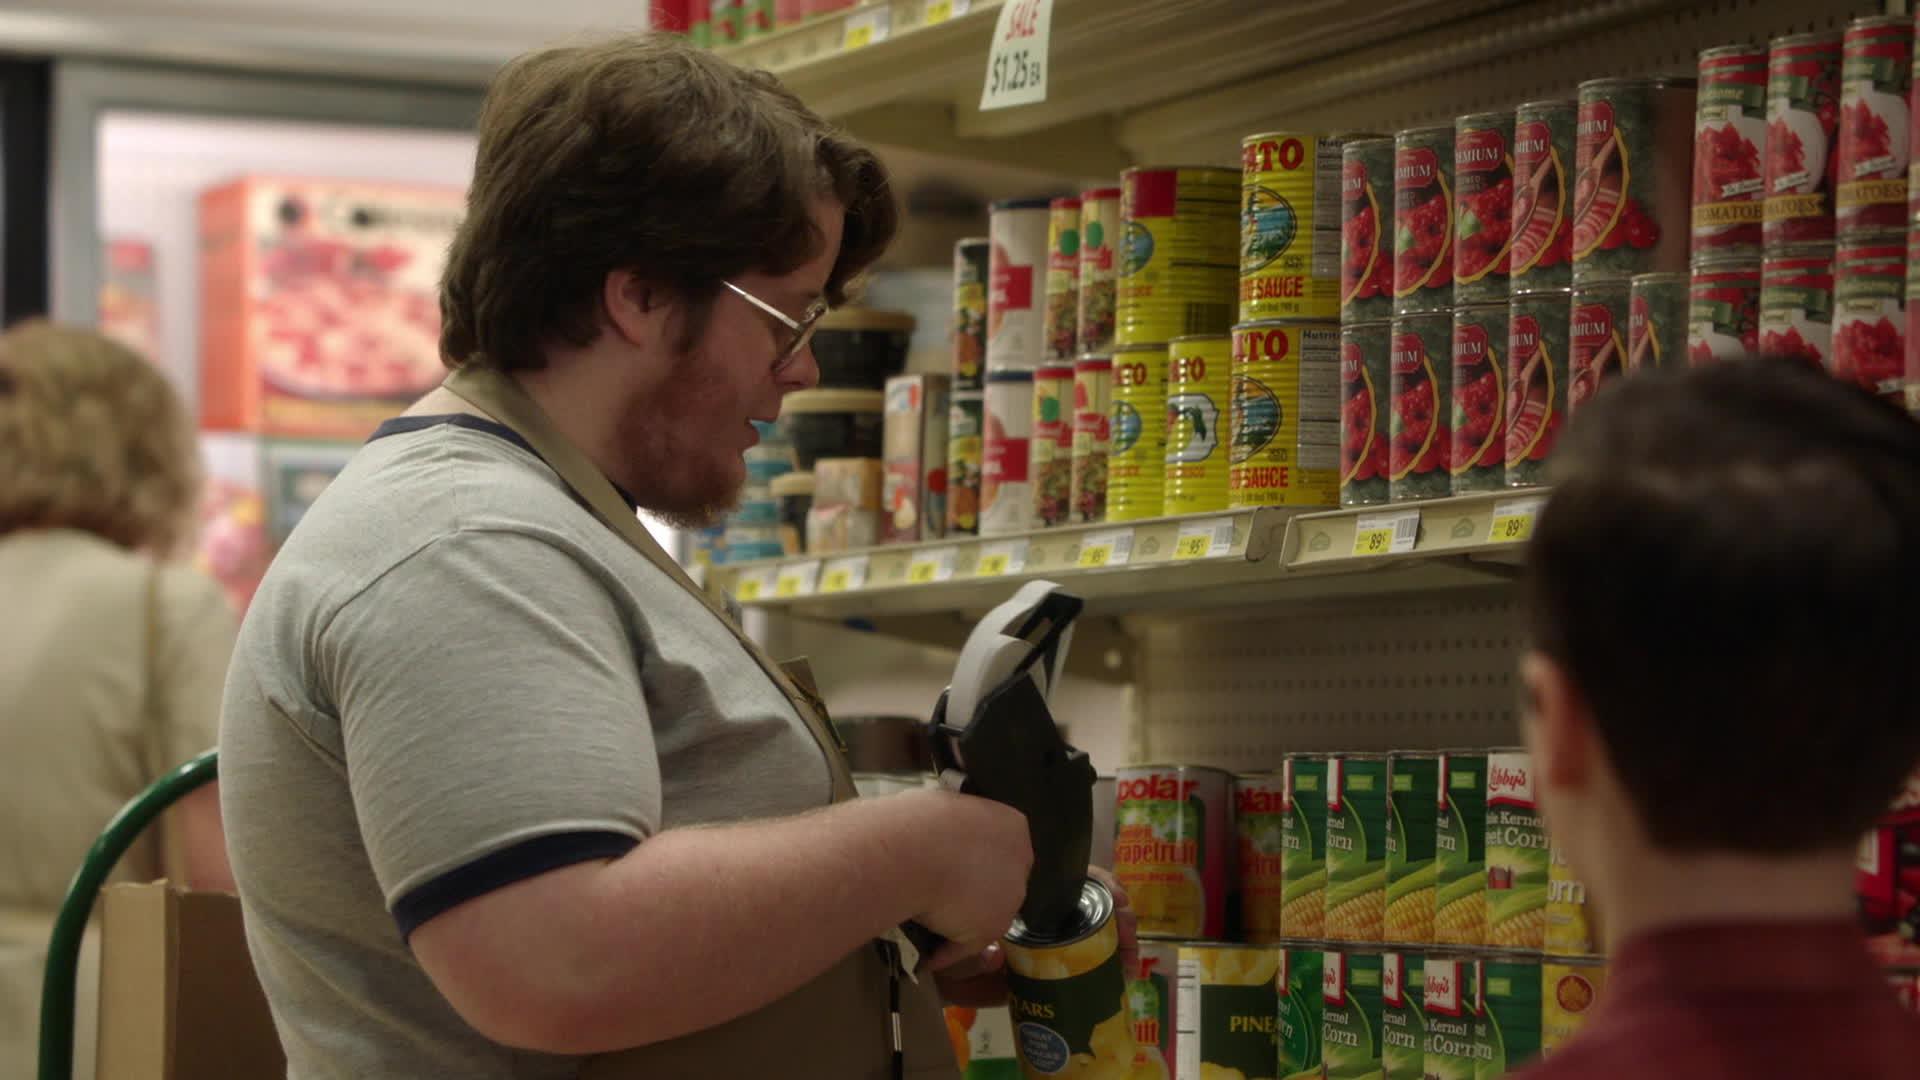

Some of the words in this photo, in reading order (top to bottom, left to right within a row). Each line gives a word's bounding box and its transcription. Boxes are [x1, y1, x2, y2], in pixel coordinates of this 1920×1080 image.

[1006, 0, 1041, 40] SALE
[991, 49, 1029, 96] $1.25
[1256, 276, 1304, 300] SAUCE
[1245, 466, 1289, 489] SAUCE
[1323, 1023, 1358, 1047] Corn
[1430, 1018, 1467, 1036] Kernel
